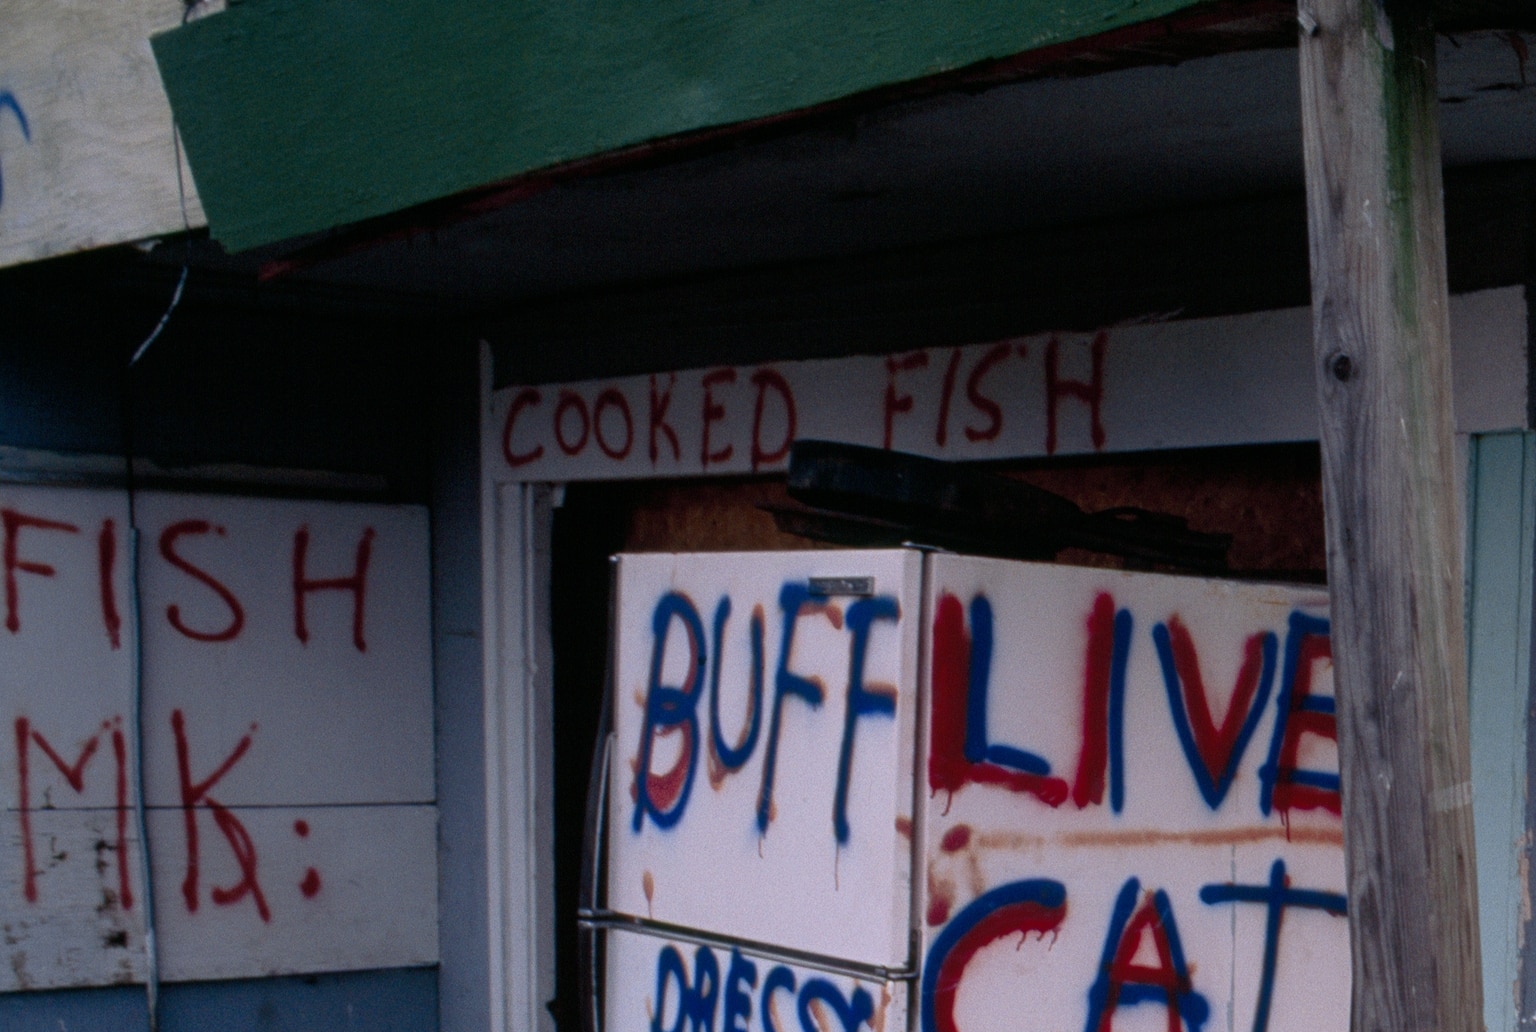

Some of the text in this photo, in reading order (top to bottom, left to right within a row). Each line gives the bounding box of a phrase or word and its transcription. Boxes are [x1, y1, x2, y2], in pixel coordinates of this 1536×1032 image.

[502, 330, 1108, 472] COOKED FISH
[1, 510, 377, 653] FISH
[630, 581, 903, 848] BUFF
[928, 590, 1343, 816] LIVE
